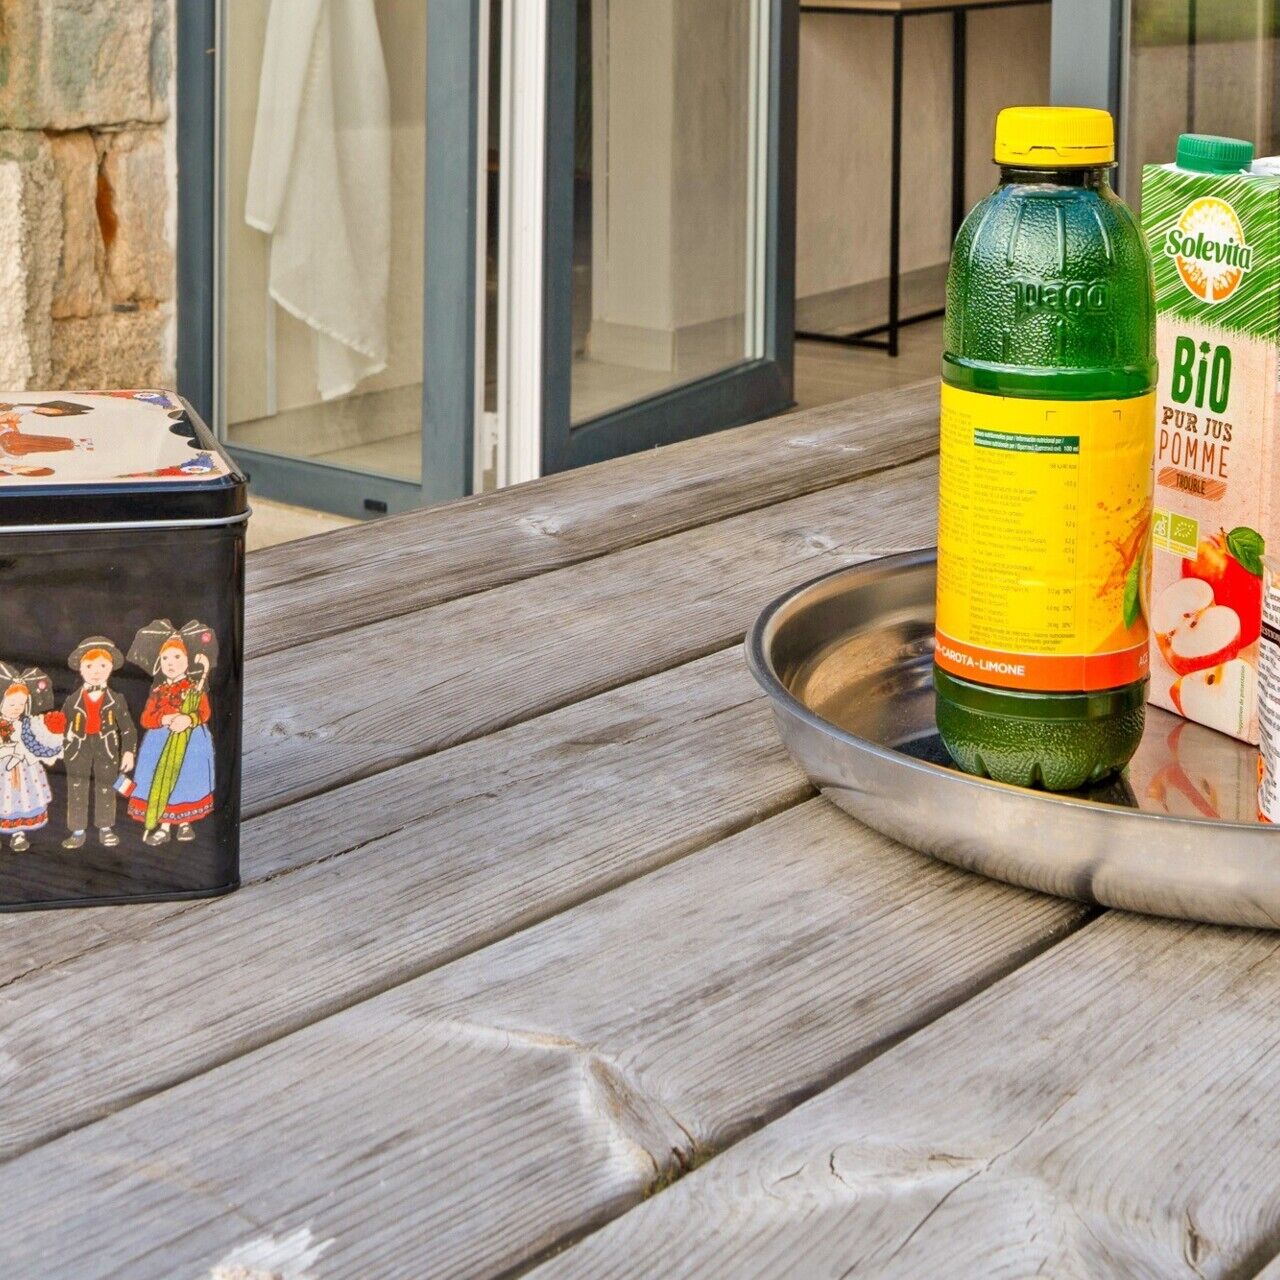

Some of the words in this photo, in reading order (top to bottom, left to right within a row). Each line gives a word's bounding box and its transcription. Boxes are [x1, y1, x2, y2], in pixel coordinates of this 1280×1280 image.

[1166, 230, 1252, 271] Solevita
[1161, 405, 1198, 433] PUR
[1203, 417, 1233, 443] JUS
[1158, 429, 1230, 479] POMME
[1176, 472, 1207, 496] TROUBLE
